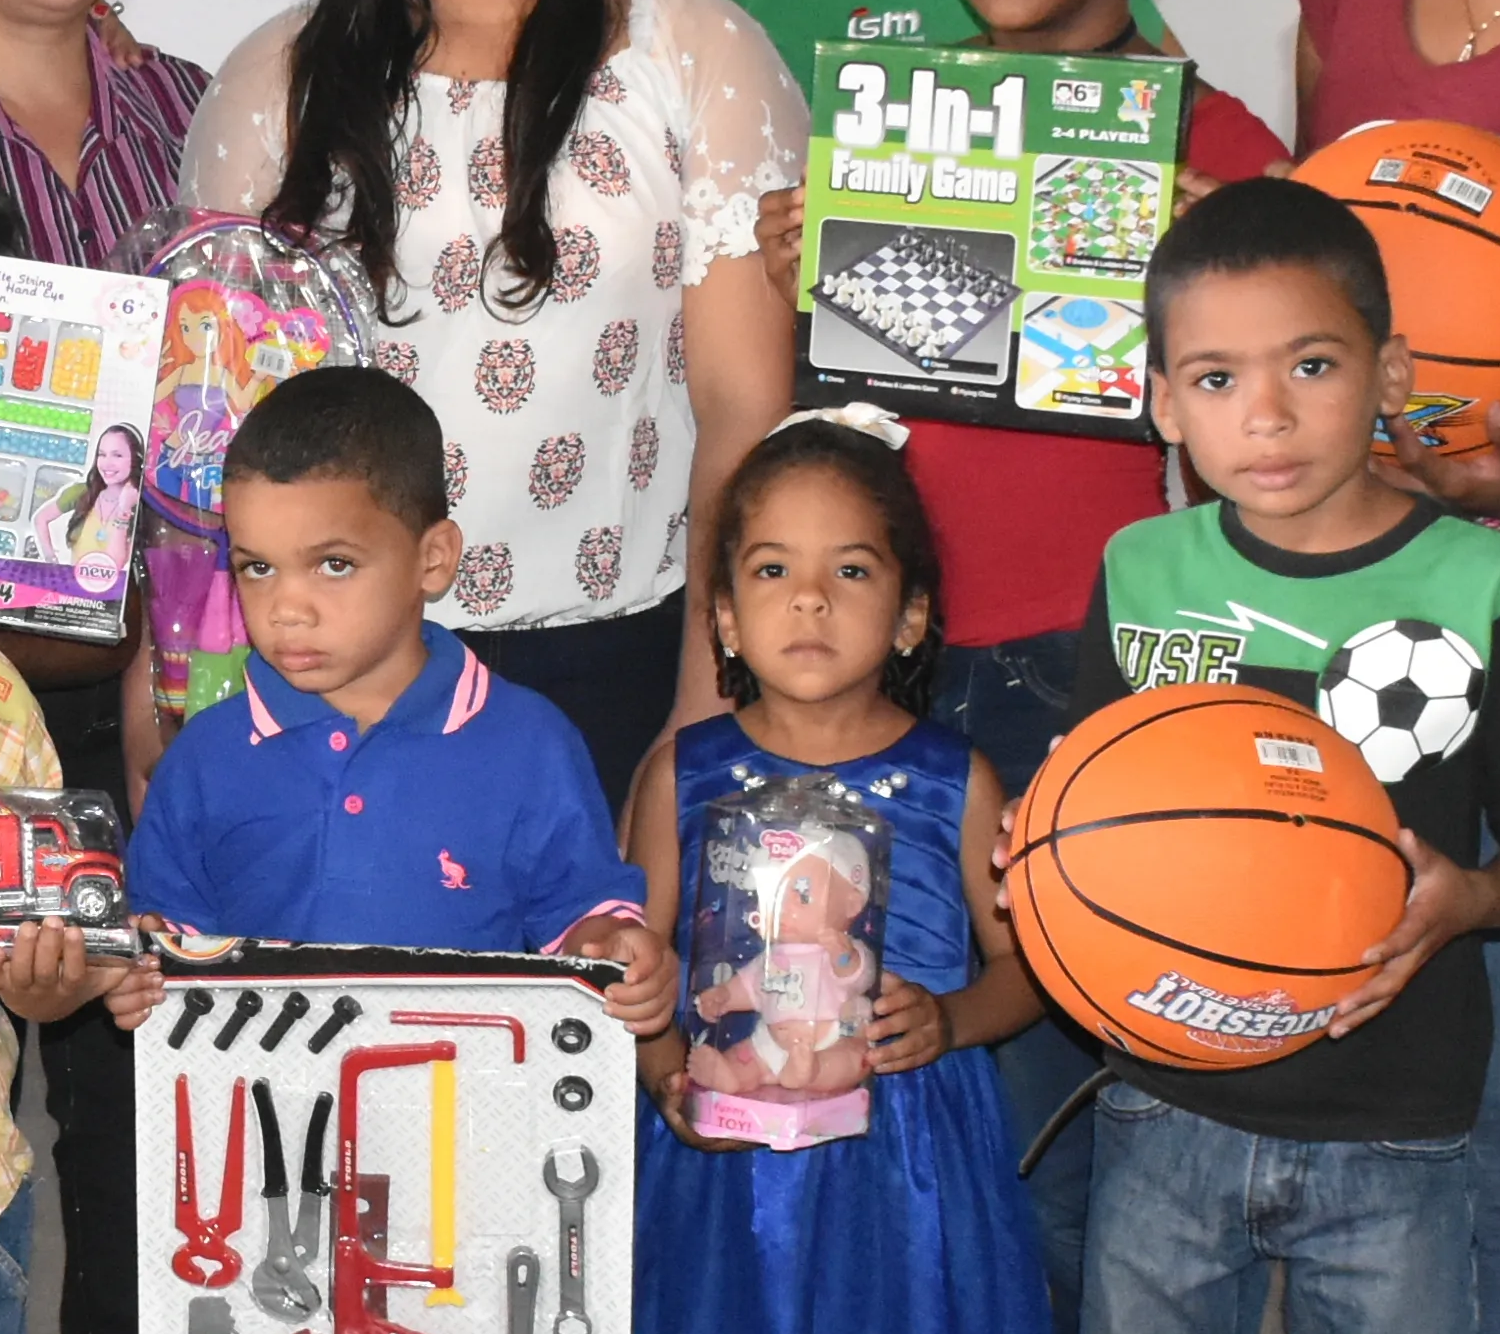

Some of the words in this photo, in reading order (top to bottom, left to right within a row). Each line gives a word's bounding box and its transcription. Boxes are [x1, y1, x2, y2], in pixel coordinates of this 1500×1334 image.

[1052, 126, 1076, 139] 2-4
[1079, 128, 1150, 145] PLAYERS
[830, 147, 928, 204] Family
[930, 155, 1018, 204] Game
[6, 282, 38, 298] Hand
[43, 288, 65, 302] Eye
[18, 273, 55, 291] String
[170, 410, 231, 468] Jea
[79, 565, 116, 580] new
[58, 593, 107, 611] WARNING:
[1115, 623, 1246, 692] USE
[1127, 975, 1337, 1039] NICESHOT
[1166, 969, 1294, 1015] BASKETBALL
[178, 1151, 188, 1194] TOOLS
[570, 1235, 579, 1278] TOOLS
